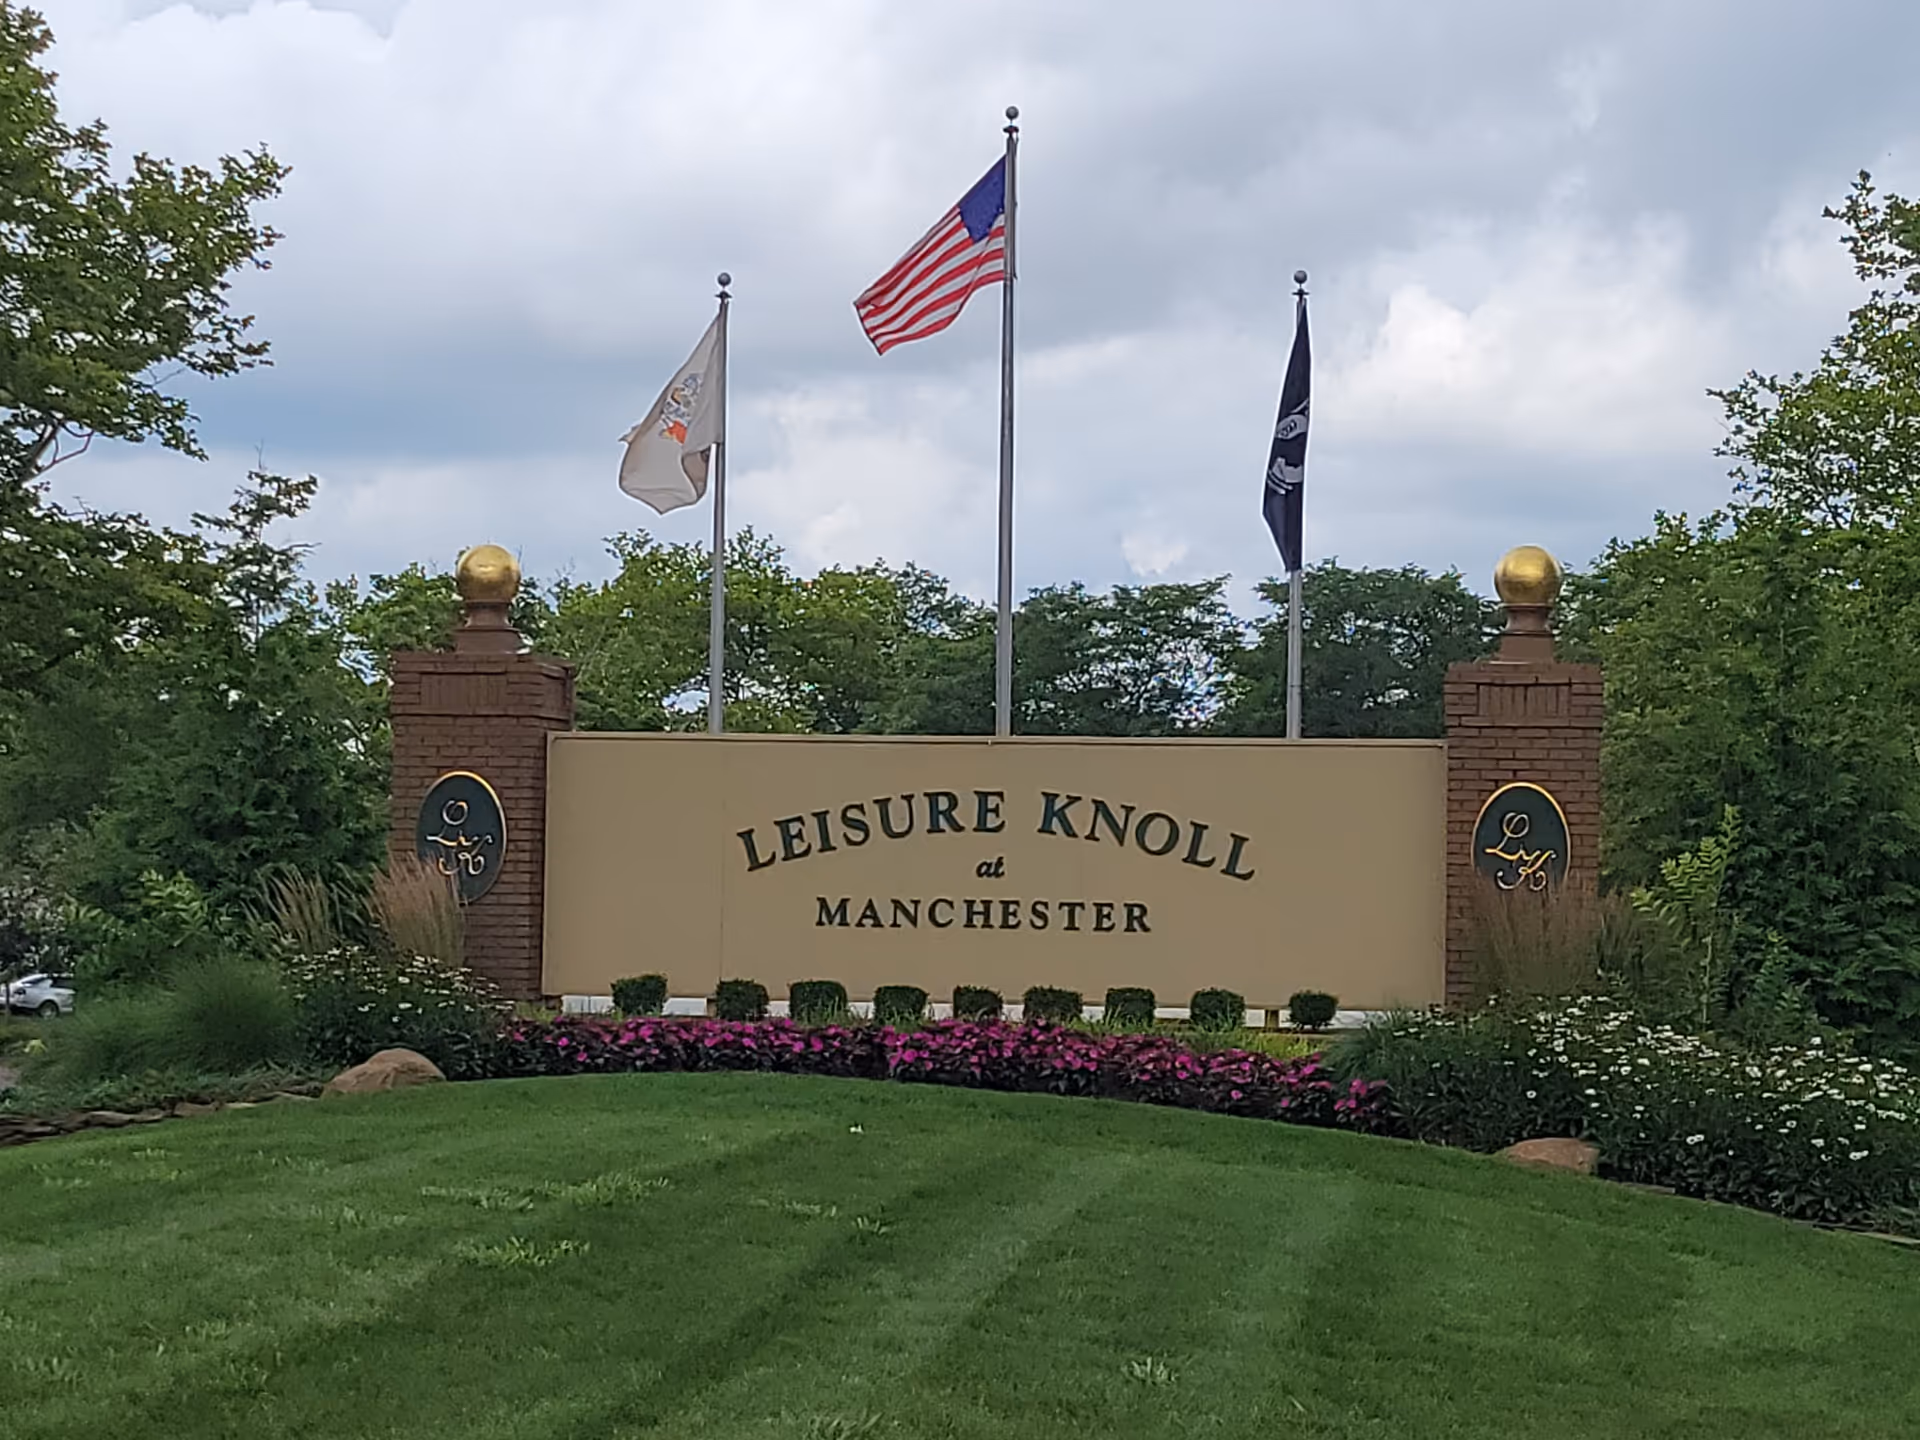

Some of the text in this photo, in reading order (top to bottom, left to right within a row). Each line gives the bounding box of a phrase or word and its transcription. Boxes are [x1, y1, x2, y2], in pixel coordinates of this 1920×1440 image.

[737, 791, 1255, 880] LEISURE KNOLL
[976, 857, 1005, 878] at
[816, 897, 1151, 932] MANCHESTER
